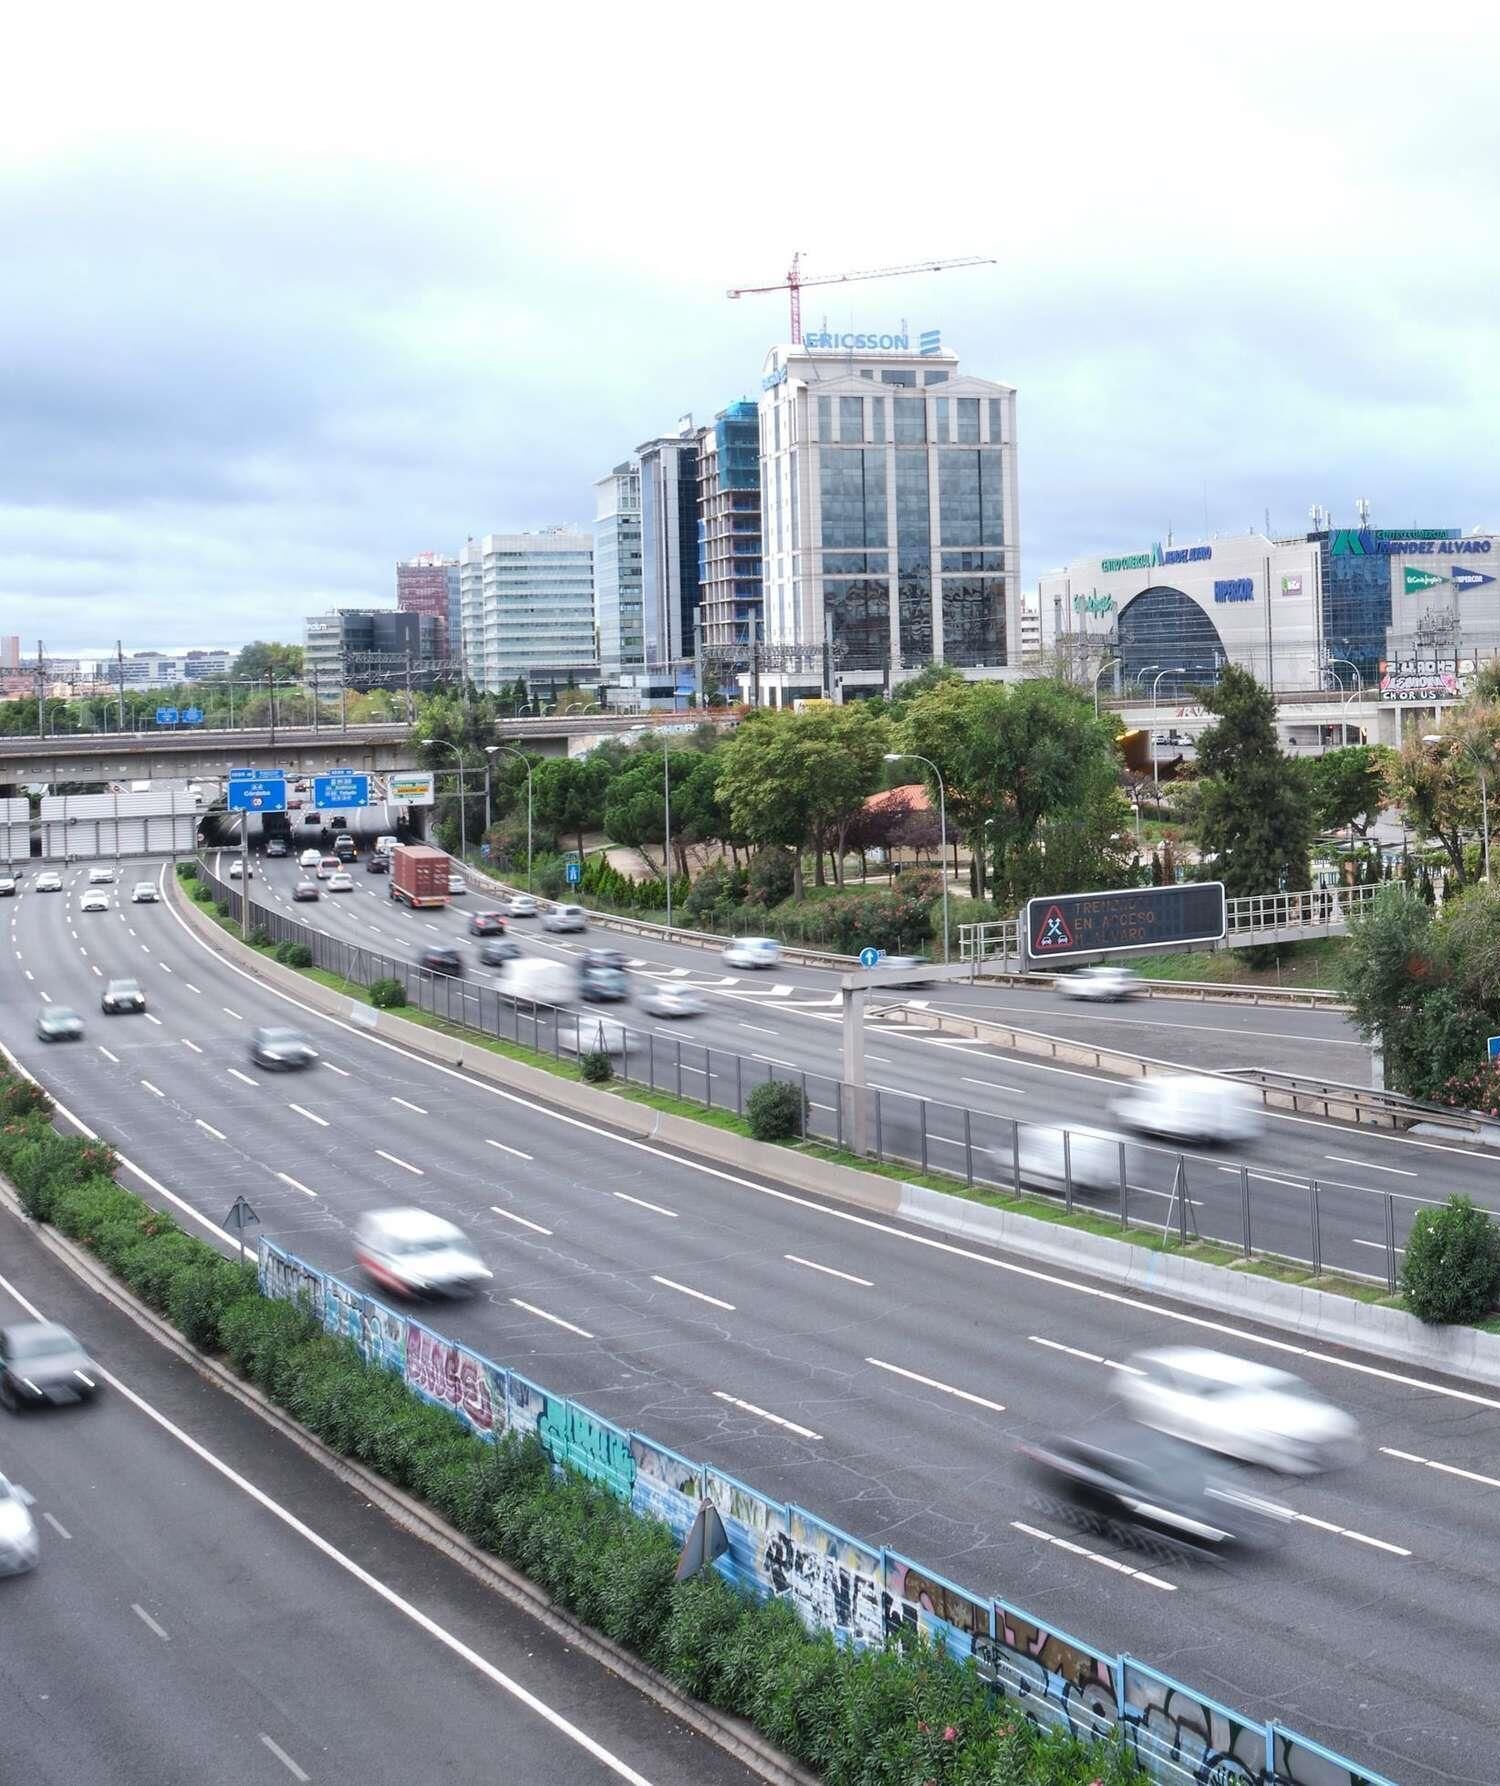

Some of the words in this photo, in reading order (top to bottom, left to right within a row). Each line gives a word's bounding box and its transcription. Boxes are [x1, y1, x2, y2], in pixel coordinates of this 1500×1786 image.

[806, 332, 909, 350] ERICSSON
[1438, 540, 1492, 554] ALVARO
[1074, 917, 1092, 930] EN
